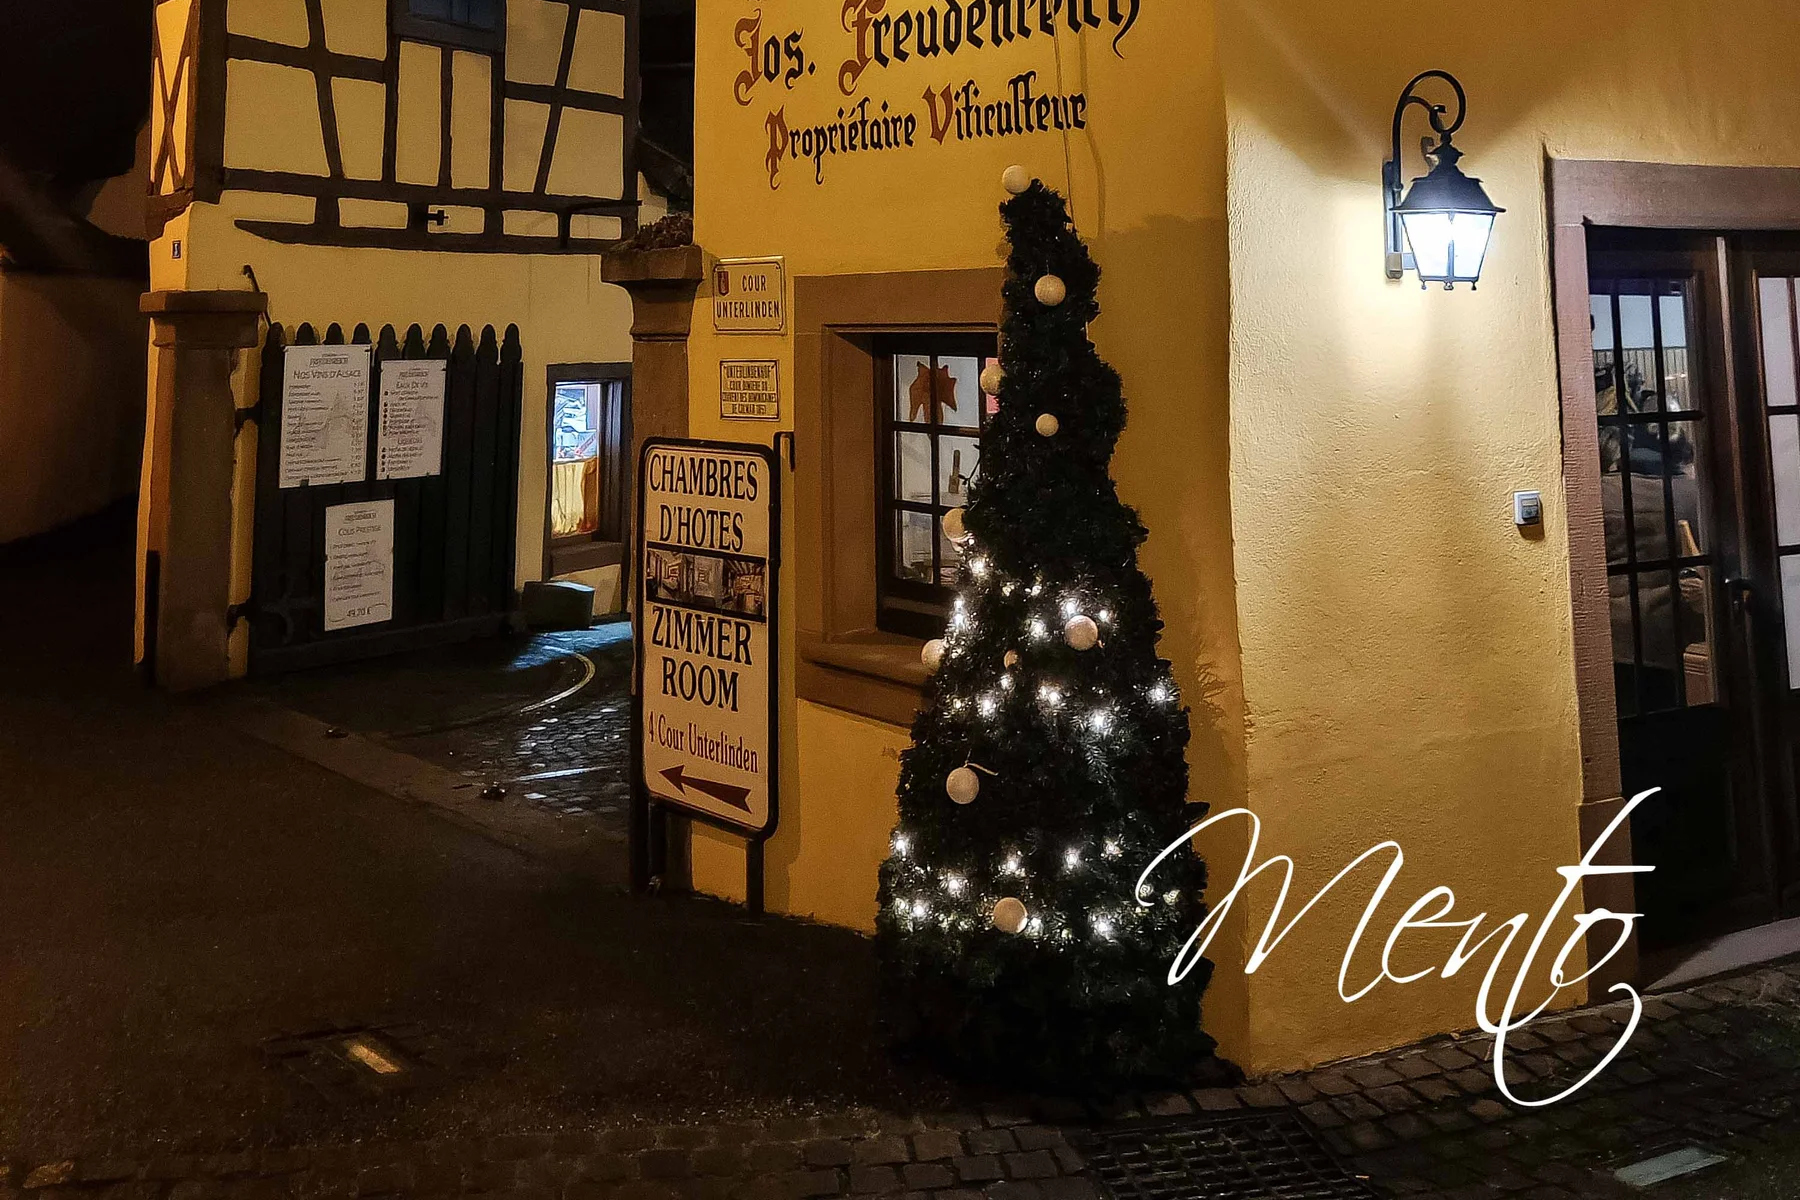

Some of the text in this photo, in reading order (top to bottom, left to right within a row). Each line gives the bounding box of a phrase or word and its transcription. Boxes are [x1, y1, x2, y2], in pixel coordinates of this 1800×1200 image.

[733, 8, 816, 105] Jos.
[765, 71, 1087, 191] Propriétaire Viticulteur
[716, 300, 780, 319] UNTERLINDEN
[742, 274, 766, 292] COUR
[649, 452, 759, 501] CHAMBRES
[659, 504, 744, 553] D'HOTES
[652, 606, 752, 665] ZIMMER
[662, 656, 739, 712] ROOM
[648, 711, 759, 773] 4 Cour Unterlinden
